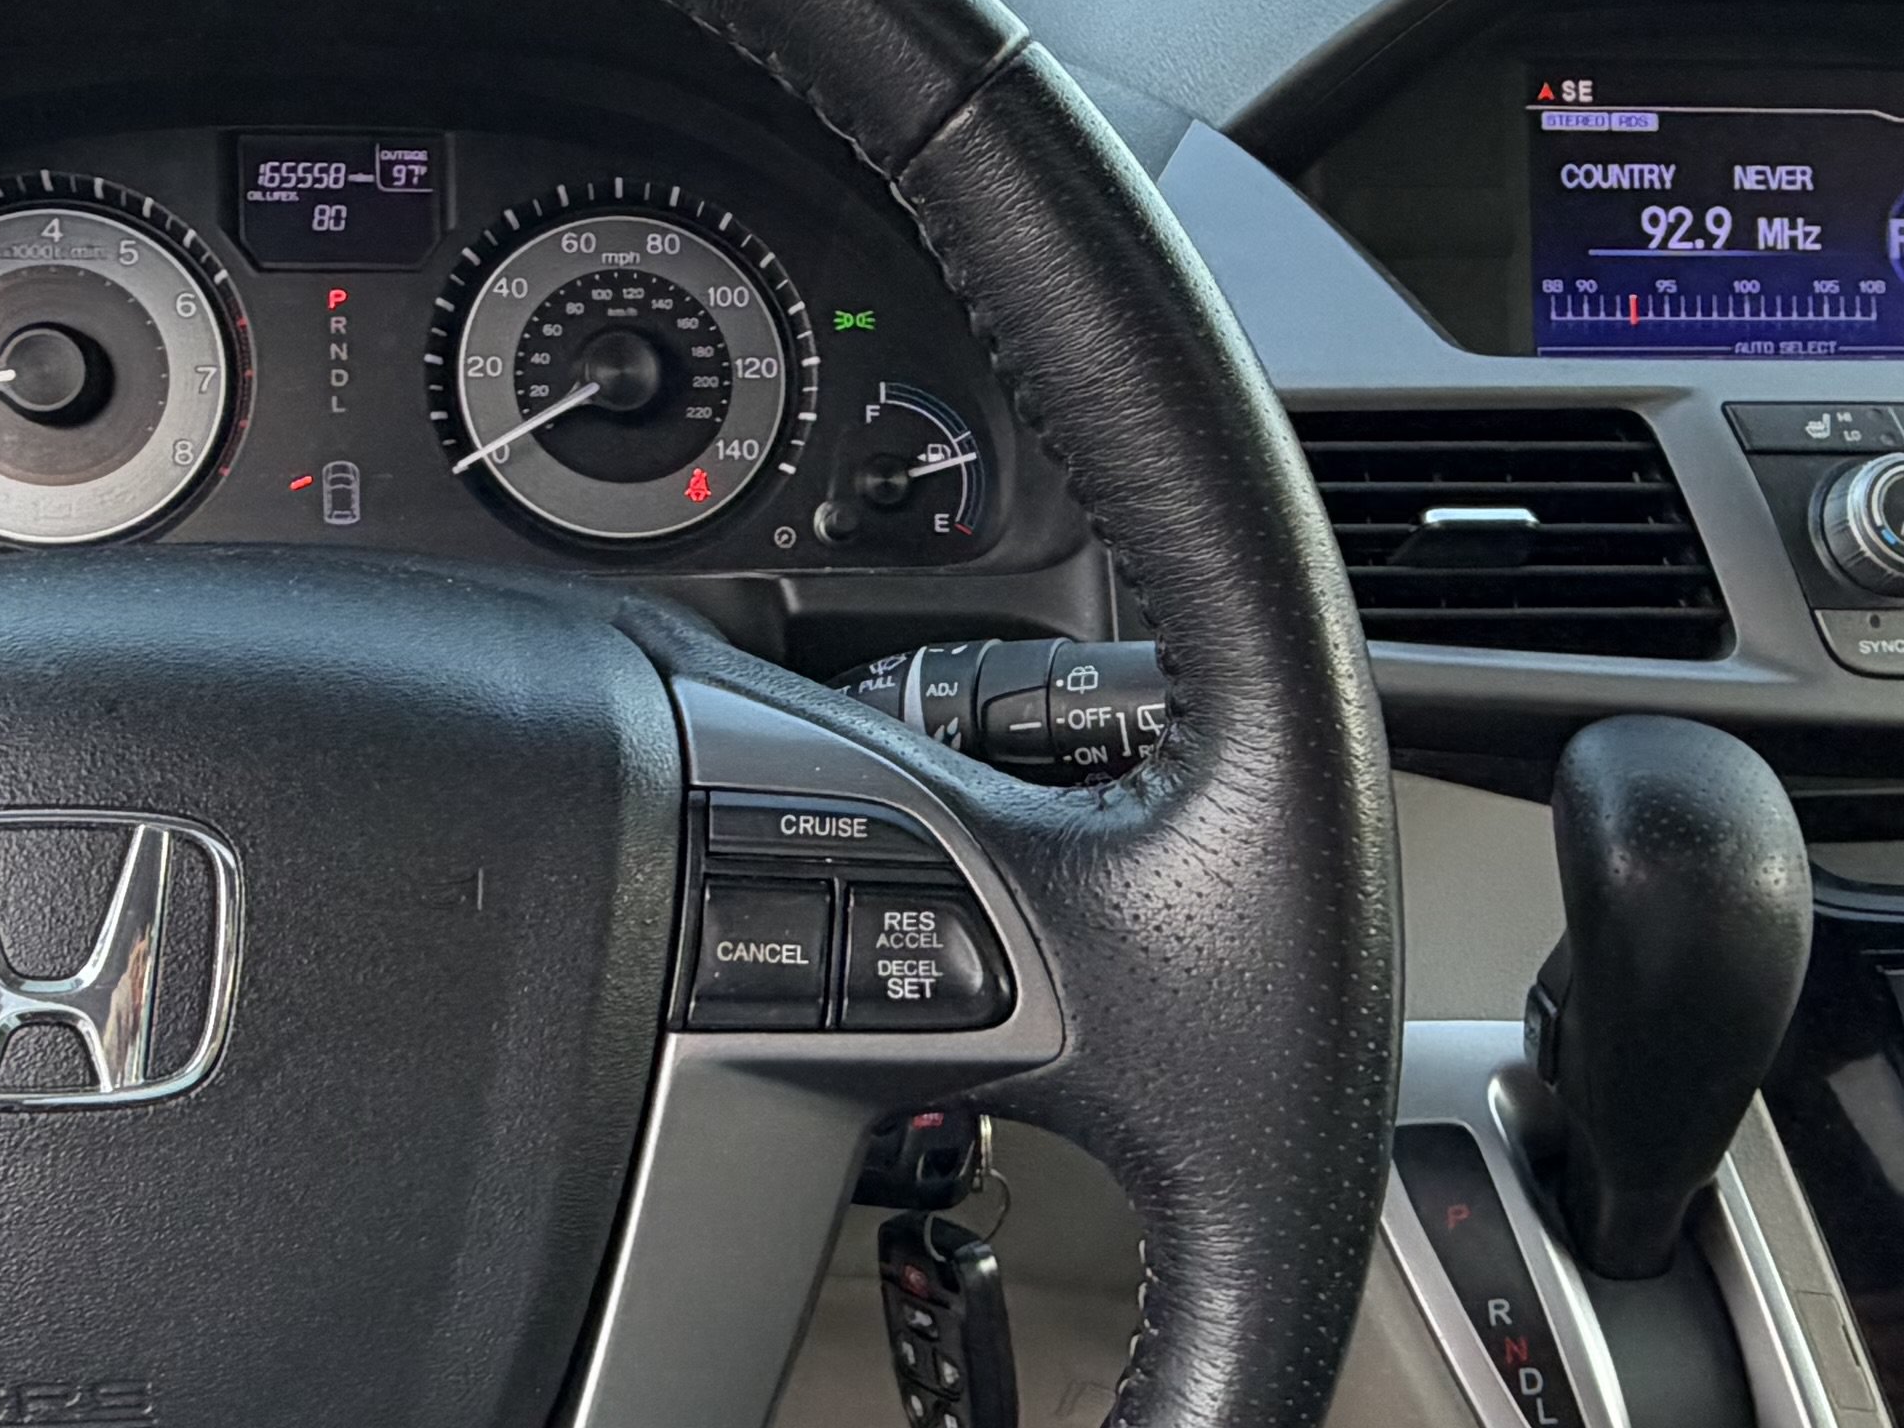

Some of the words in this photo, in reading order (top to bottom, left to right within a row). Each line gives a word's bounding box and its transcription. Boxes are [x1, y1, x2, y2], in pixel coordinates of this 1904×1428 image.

[1561, 79, 1593, 102] SE
[1547, 115, 1605, 128] STEREO
[1618, 115, 1649, 128] RDS
[1560, 163, 1676, 191] COUNTRY
[1733, 165, 1814, 192] NEVER
[312, 204, 347, 231] 80
[41, 218, 63, 242] 4
[1641, 206, 1733, 252] 92.9
[1757, 218, 1823, 252] MHz
[118, 239, 140, 265] 5
[560, 232, 596, 254] 60
[646, 233, 681, 255] 80
[601, 251, 641, 269] mph
[493, 277, 528, 299] 40
[707, 286, 750, 308] 100
[1542, 280, 1563, 293] 88
[1576, 280, 1597, 293] 90
[1656, 280, 1677, 293] 95
[1733, 280, 1760, 293] 100
[1813, 280, 1839, 293] 105
[175, 292, 197, 318] 6
[328, 288, 348, 309] P
[330, 316, 347, 334] R
[542, 324, 563, 337] 60
[329, 342, 348, 361] N
[530, 352, 551, 365] 40
[1735, 341, 1775, 354] AUTO
[1779, 341, 1837, 354] SELECT
[331, 368, 349, 387] D
[467, 356, 503, 378] 20
[734, 357, 779, 379] 120
[195, 365, 218, 393] 7
[692, 375, 720, 388] 200
[529, 384, 550, 398] 20
[331, 395, 346, 413] L
[685, 405, 713, 419] 220
[865, 404, 881, 424] F
[172, 439, 195, 466] 8
[716, 439, 760, 461] 140
[933, 513, 950, 533] E
[858, 675, 897, 694] PULL
[925, 682, 959, 697] ADJ
[1067, 706, 1112, 730] OFF
[1074, 745, 1109, 765] ON
[780, 814, 868, 838] CRUISE
[883, 910, 936, 932] RES
[875, 932, 944, 949] ACCEL
[716, 940, 810, 966] CANCEL
[877, 959, 944, 977] DECEL
[886, 976, 936, 1000] SET
[1446, 1204, 1471, 1231] P
[1487, 1298, 1514, 1326] R
[1504, 1337, 1529, 1364] N
[1519, 1368, 1543, 1395] D
[1536, 1398, 1559, 1425] L
